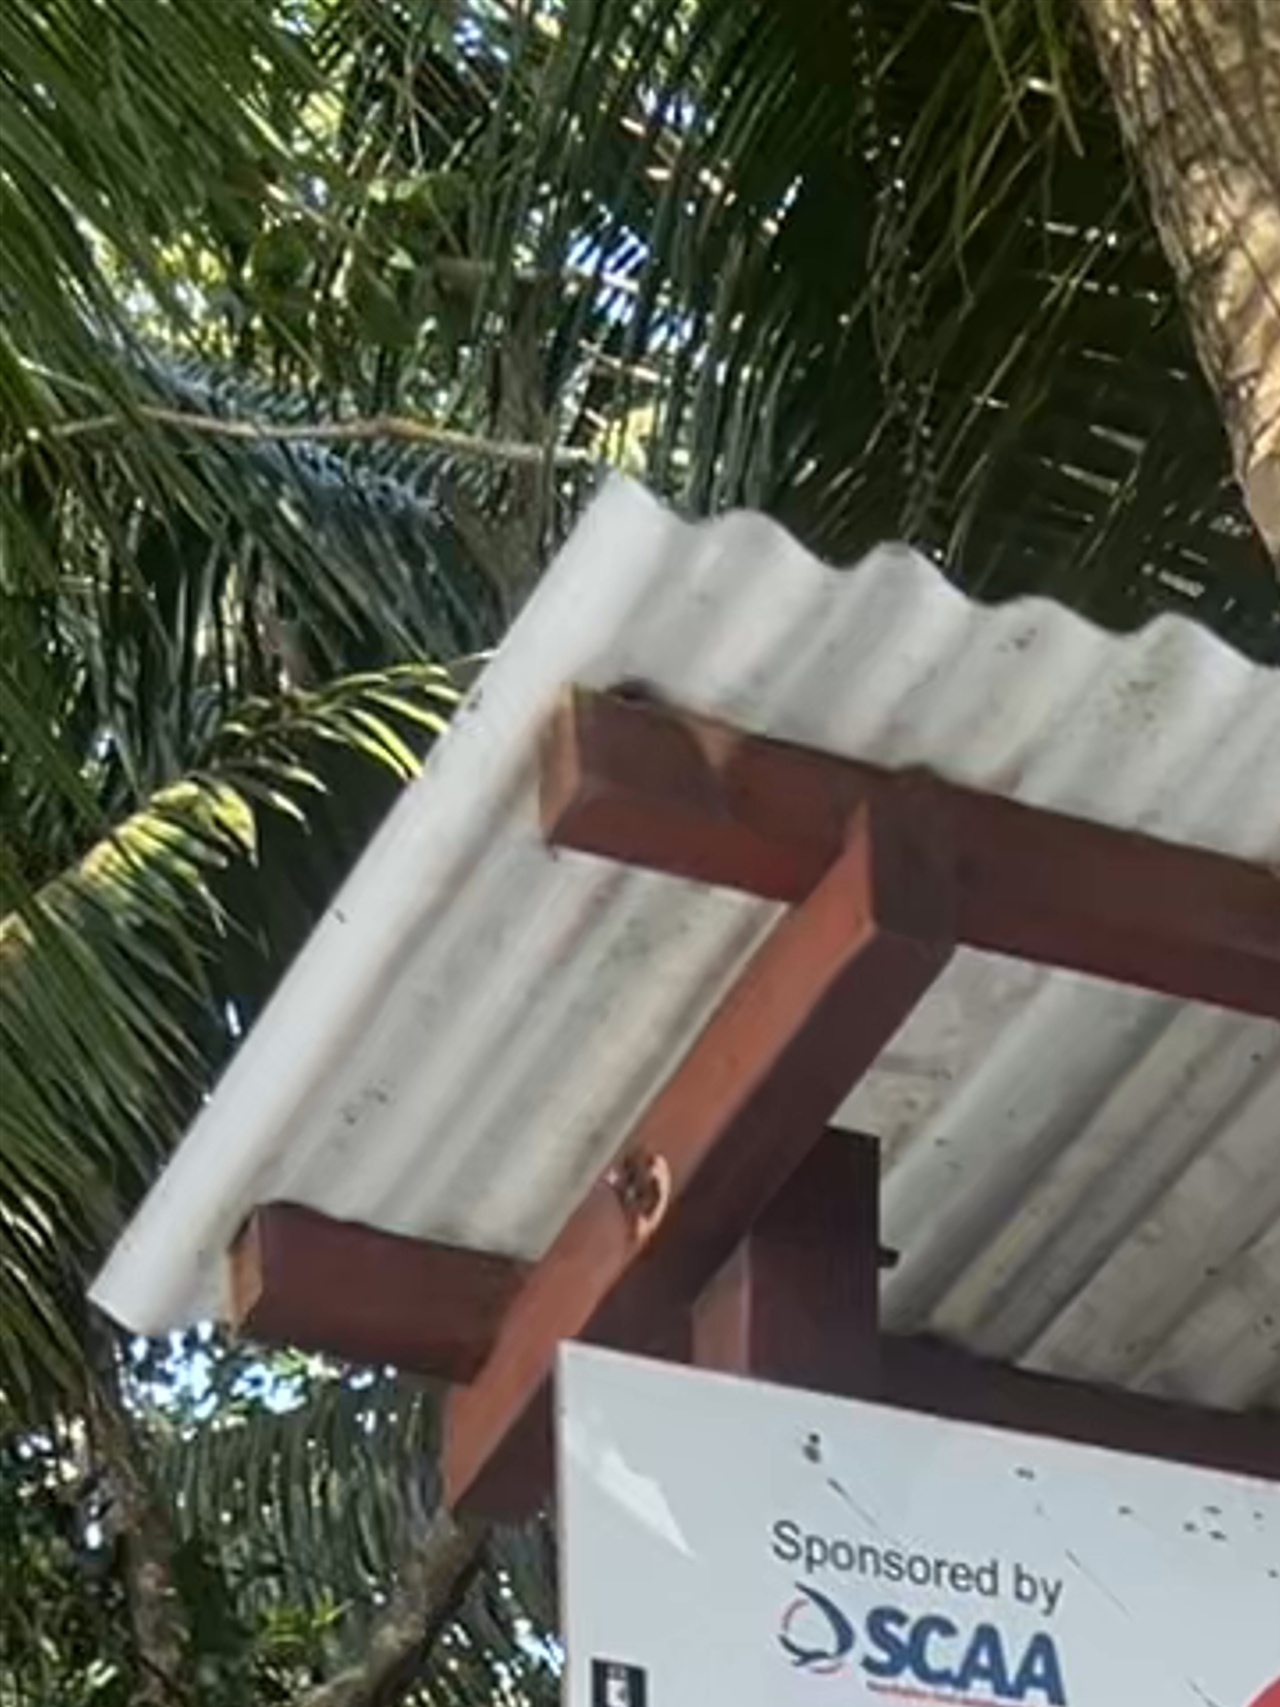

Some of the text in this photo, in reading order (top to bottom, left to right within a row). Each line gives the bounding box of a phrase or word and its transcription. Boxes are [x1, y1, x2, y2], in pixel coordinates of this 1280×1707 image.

[772, 1519, 1063, 1617] Sponsored by
[861, 1605, 1067, 1707] SCAA
